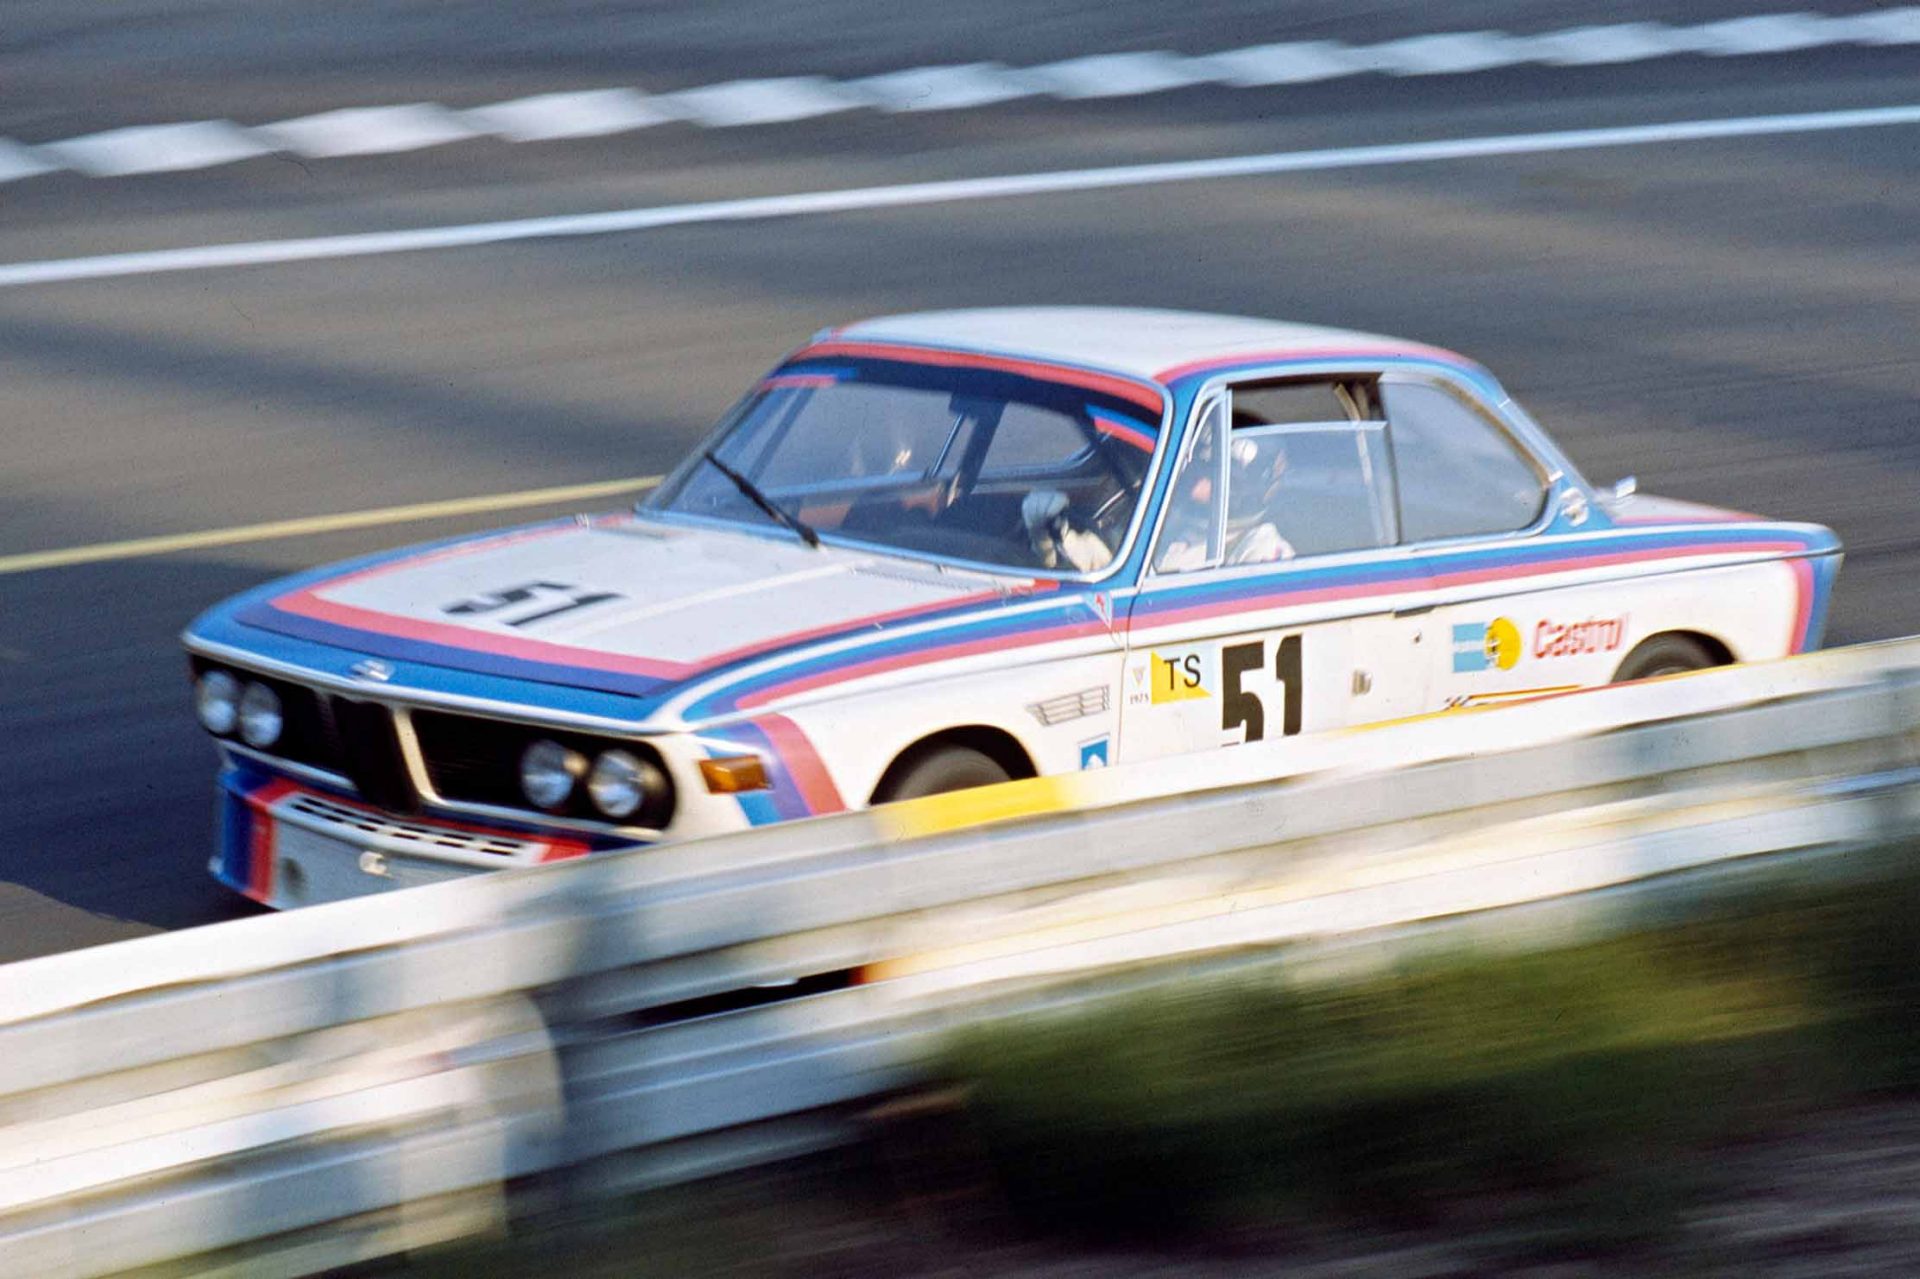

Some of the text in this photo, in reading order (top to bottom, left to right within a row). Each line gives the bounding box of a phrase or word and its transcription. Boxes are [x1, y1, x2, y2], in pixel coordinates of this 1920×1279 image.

[441, 582, 627, 626] 51
[1163, 653, 1201, 691] TS
[1221, 633, 1303, 747] 51
